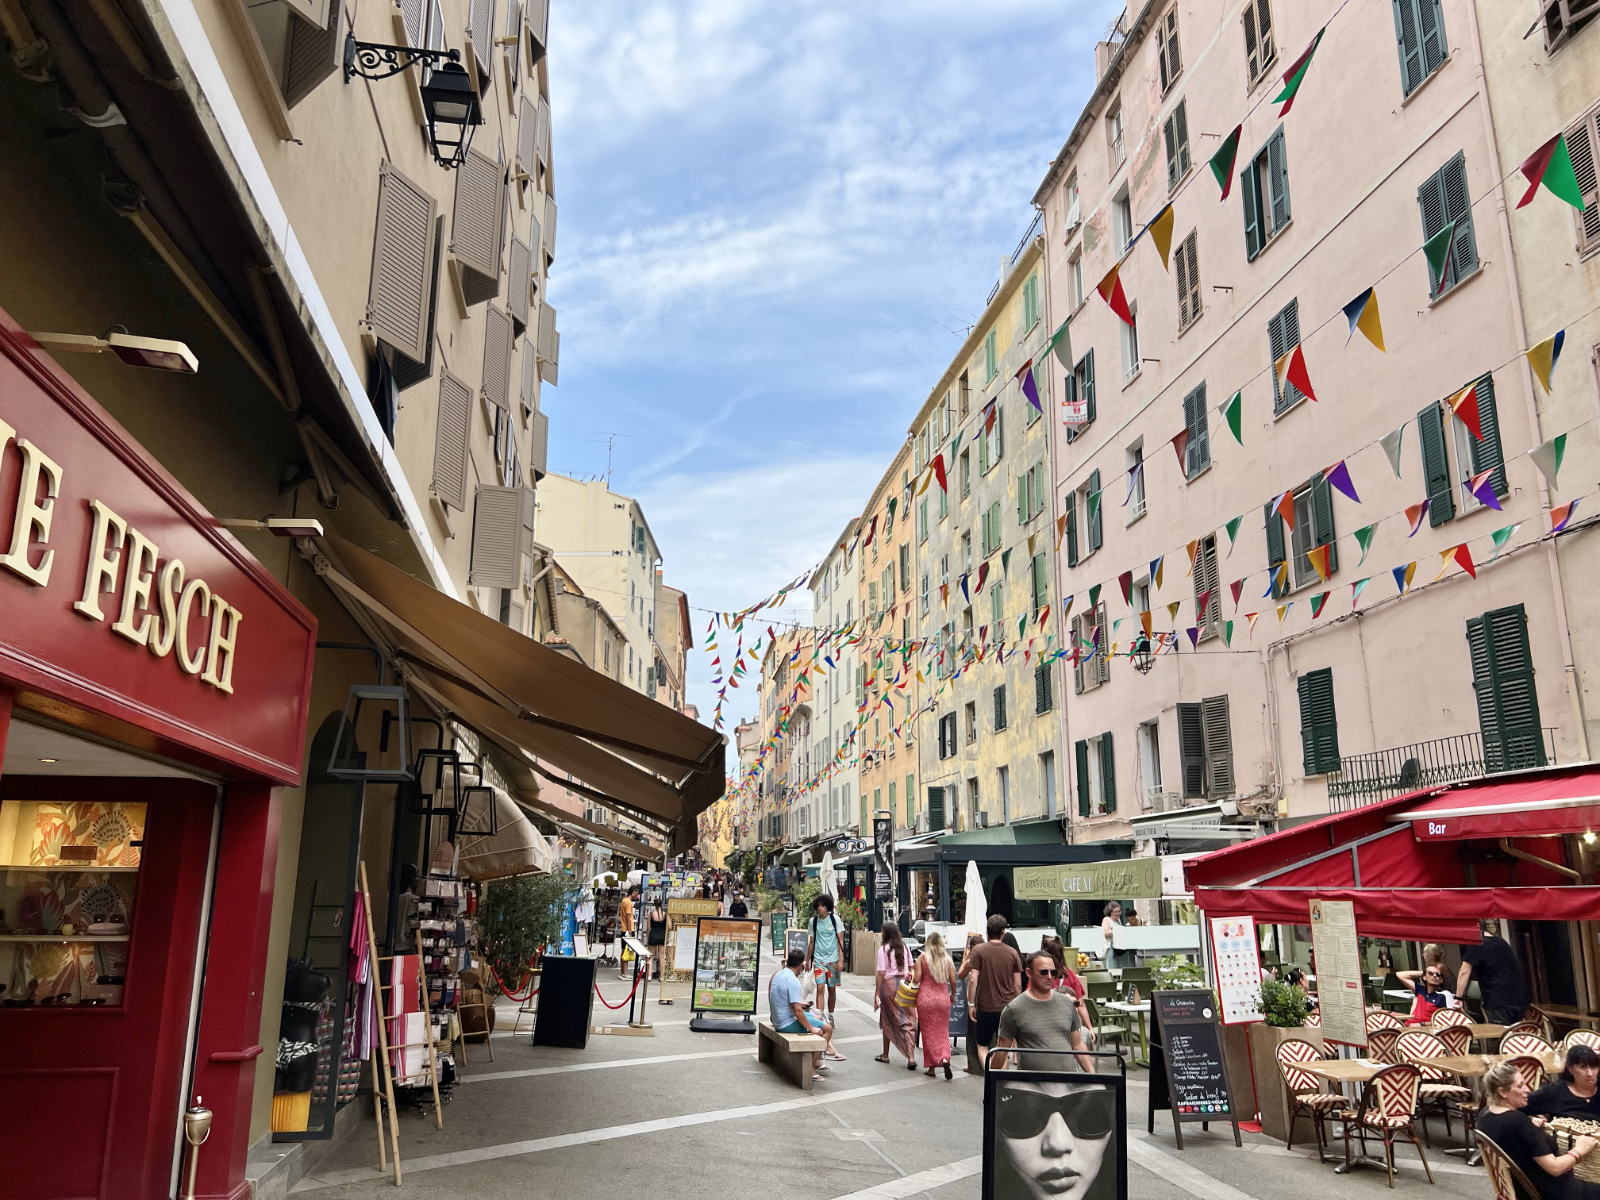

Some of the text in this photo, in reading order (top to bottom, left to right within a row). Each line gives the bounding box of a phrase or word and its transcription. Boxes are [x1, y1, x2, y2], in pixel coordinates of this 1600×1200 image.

[73, 499, 243, 694] FESCH
[1428, 821, 1446, 835] Bar
[1025, 878, 1057, 889] BRASSERIE
[1062, 873, 1081, 892] CAFÉ
[1099, 874, 1134, 888] GLACIER
[671, 901, 715, 912] ROOFTOP
